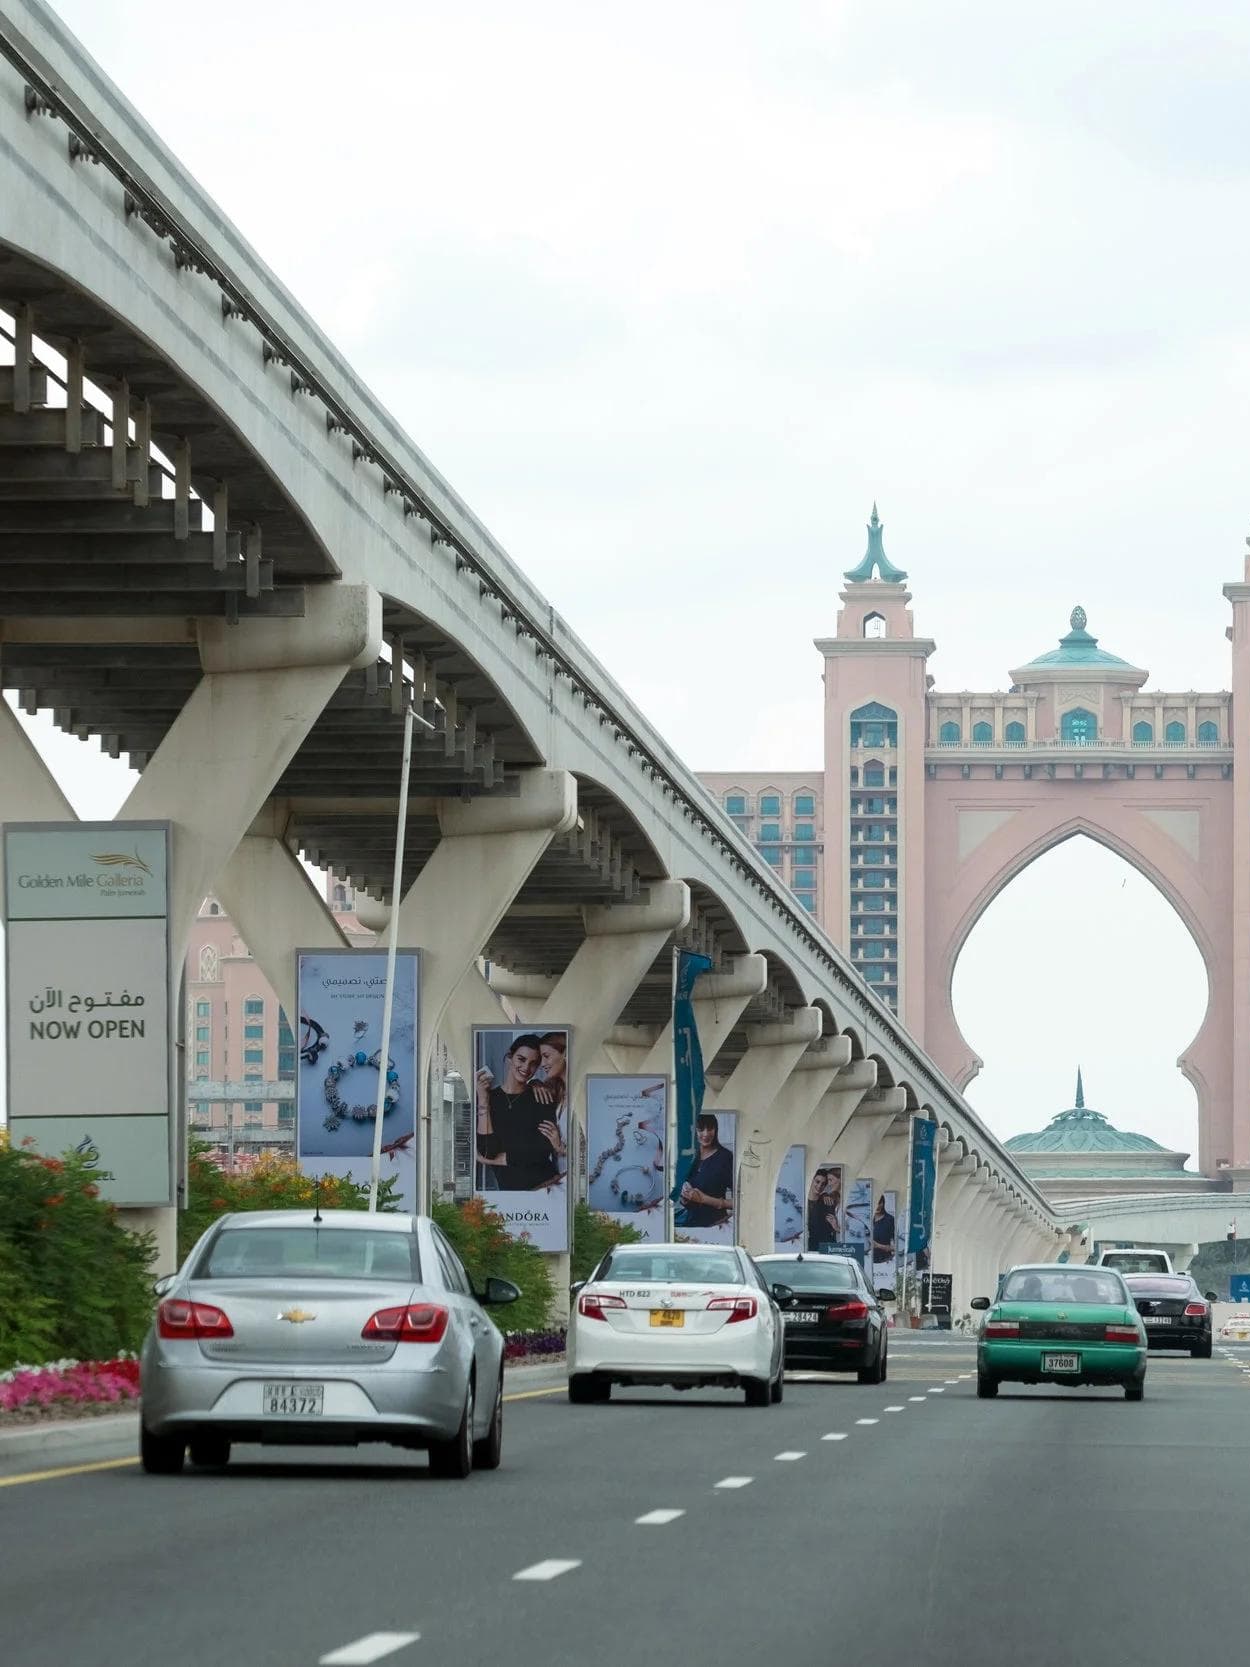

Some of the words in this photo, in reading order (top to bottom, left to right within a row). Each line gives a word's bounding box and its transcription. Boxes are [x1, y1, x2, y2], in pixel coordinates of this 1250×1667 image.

[18, 873, 64, 888] Golden
[66, 873, 94, 888] Mile
[96, 873, 144, 888] Galleria
[29, 986, 63, 1014] الآن
[68, 989, 145, 1013] مفتوح
[30, 1021, 81, 1040] NOW
[88, 1019, 145, 1039] OPEN
[620, 1290, 635, 1298] HTD
[1048, 1359, 1074, 1368] 37608
[270, 1398, 316, 1414] 84372
